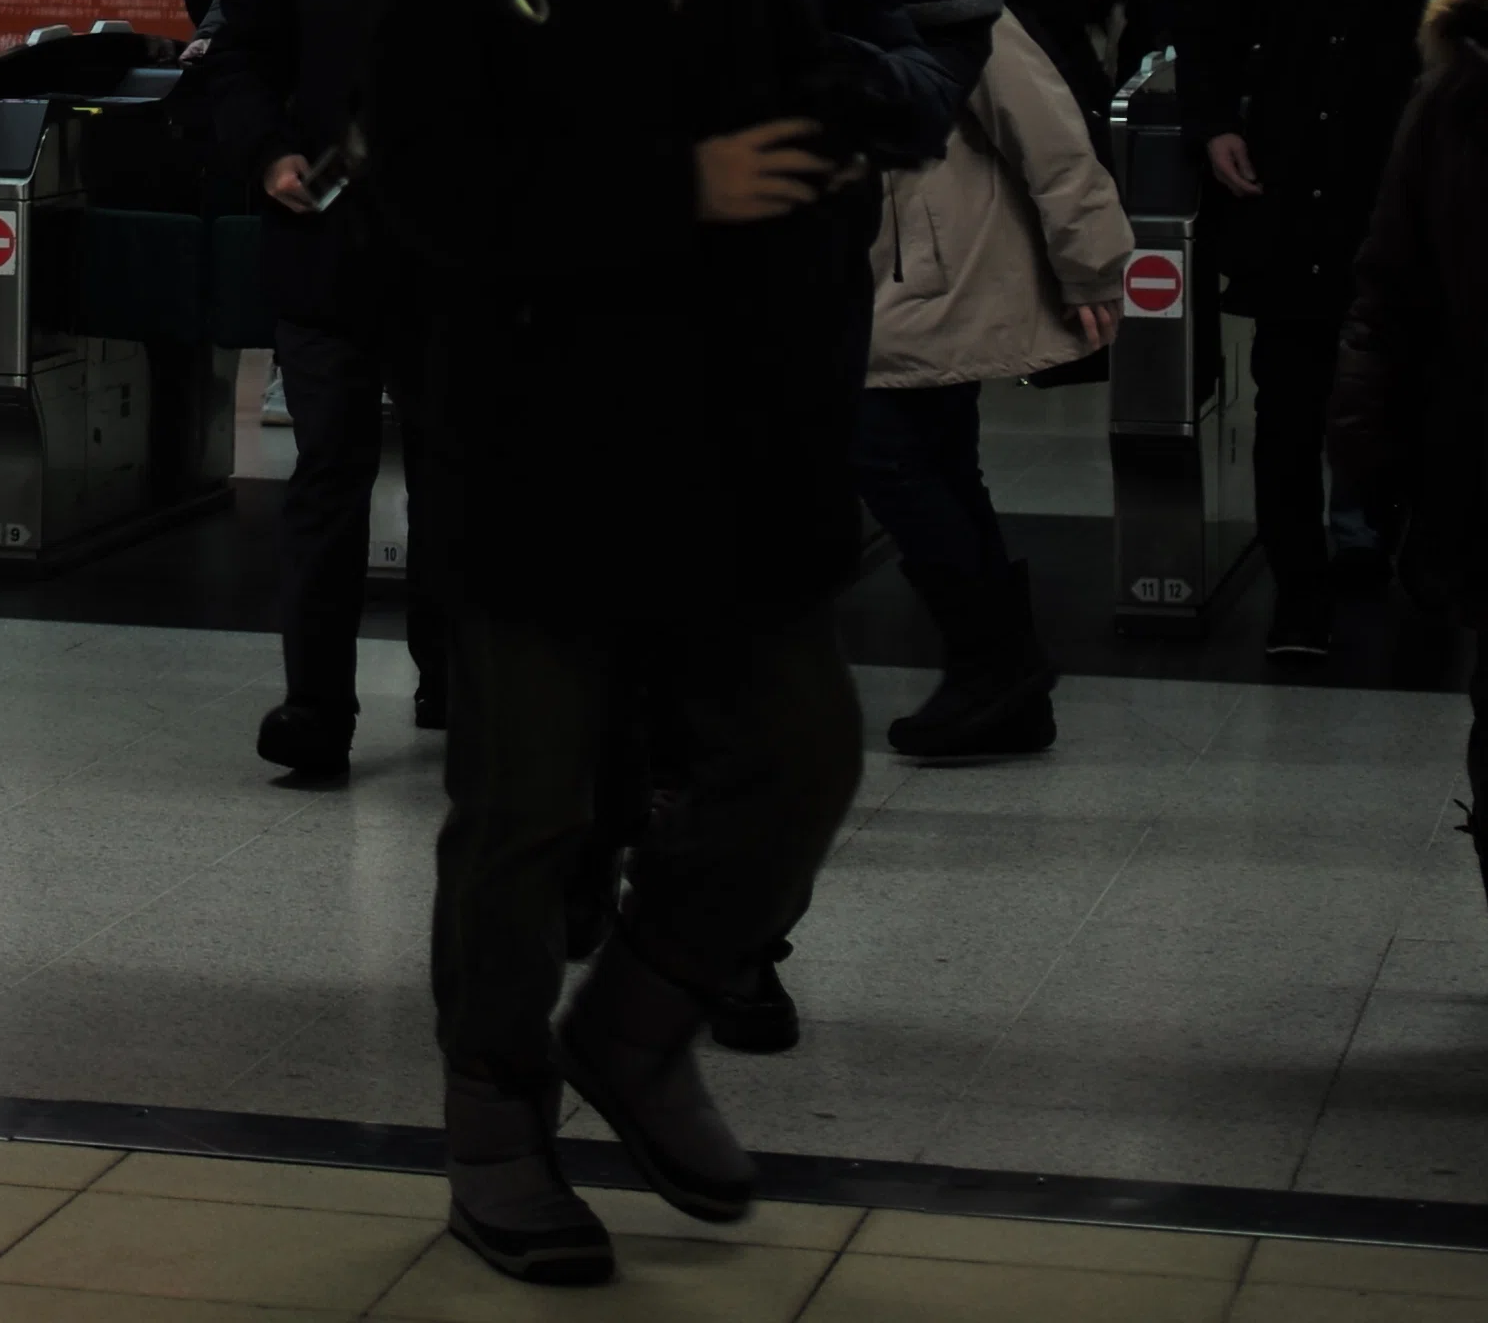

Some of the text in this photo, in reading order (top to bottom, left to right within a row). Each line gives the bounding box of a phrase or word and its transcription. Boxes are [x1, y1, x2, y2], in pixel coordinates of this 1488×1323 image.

[10, 527, 21, 542] 9
[383, 547, 397, 562] 10
[1141, 583, 1182, 597] 11 12
